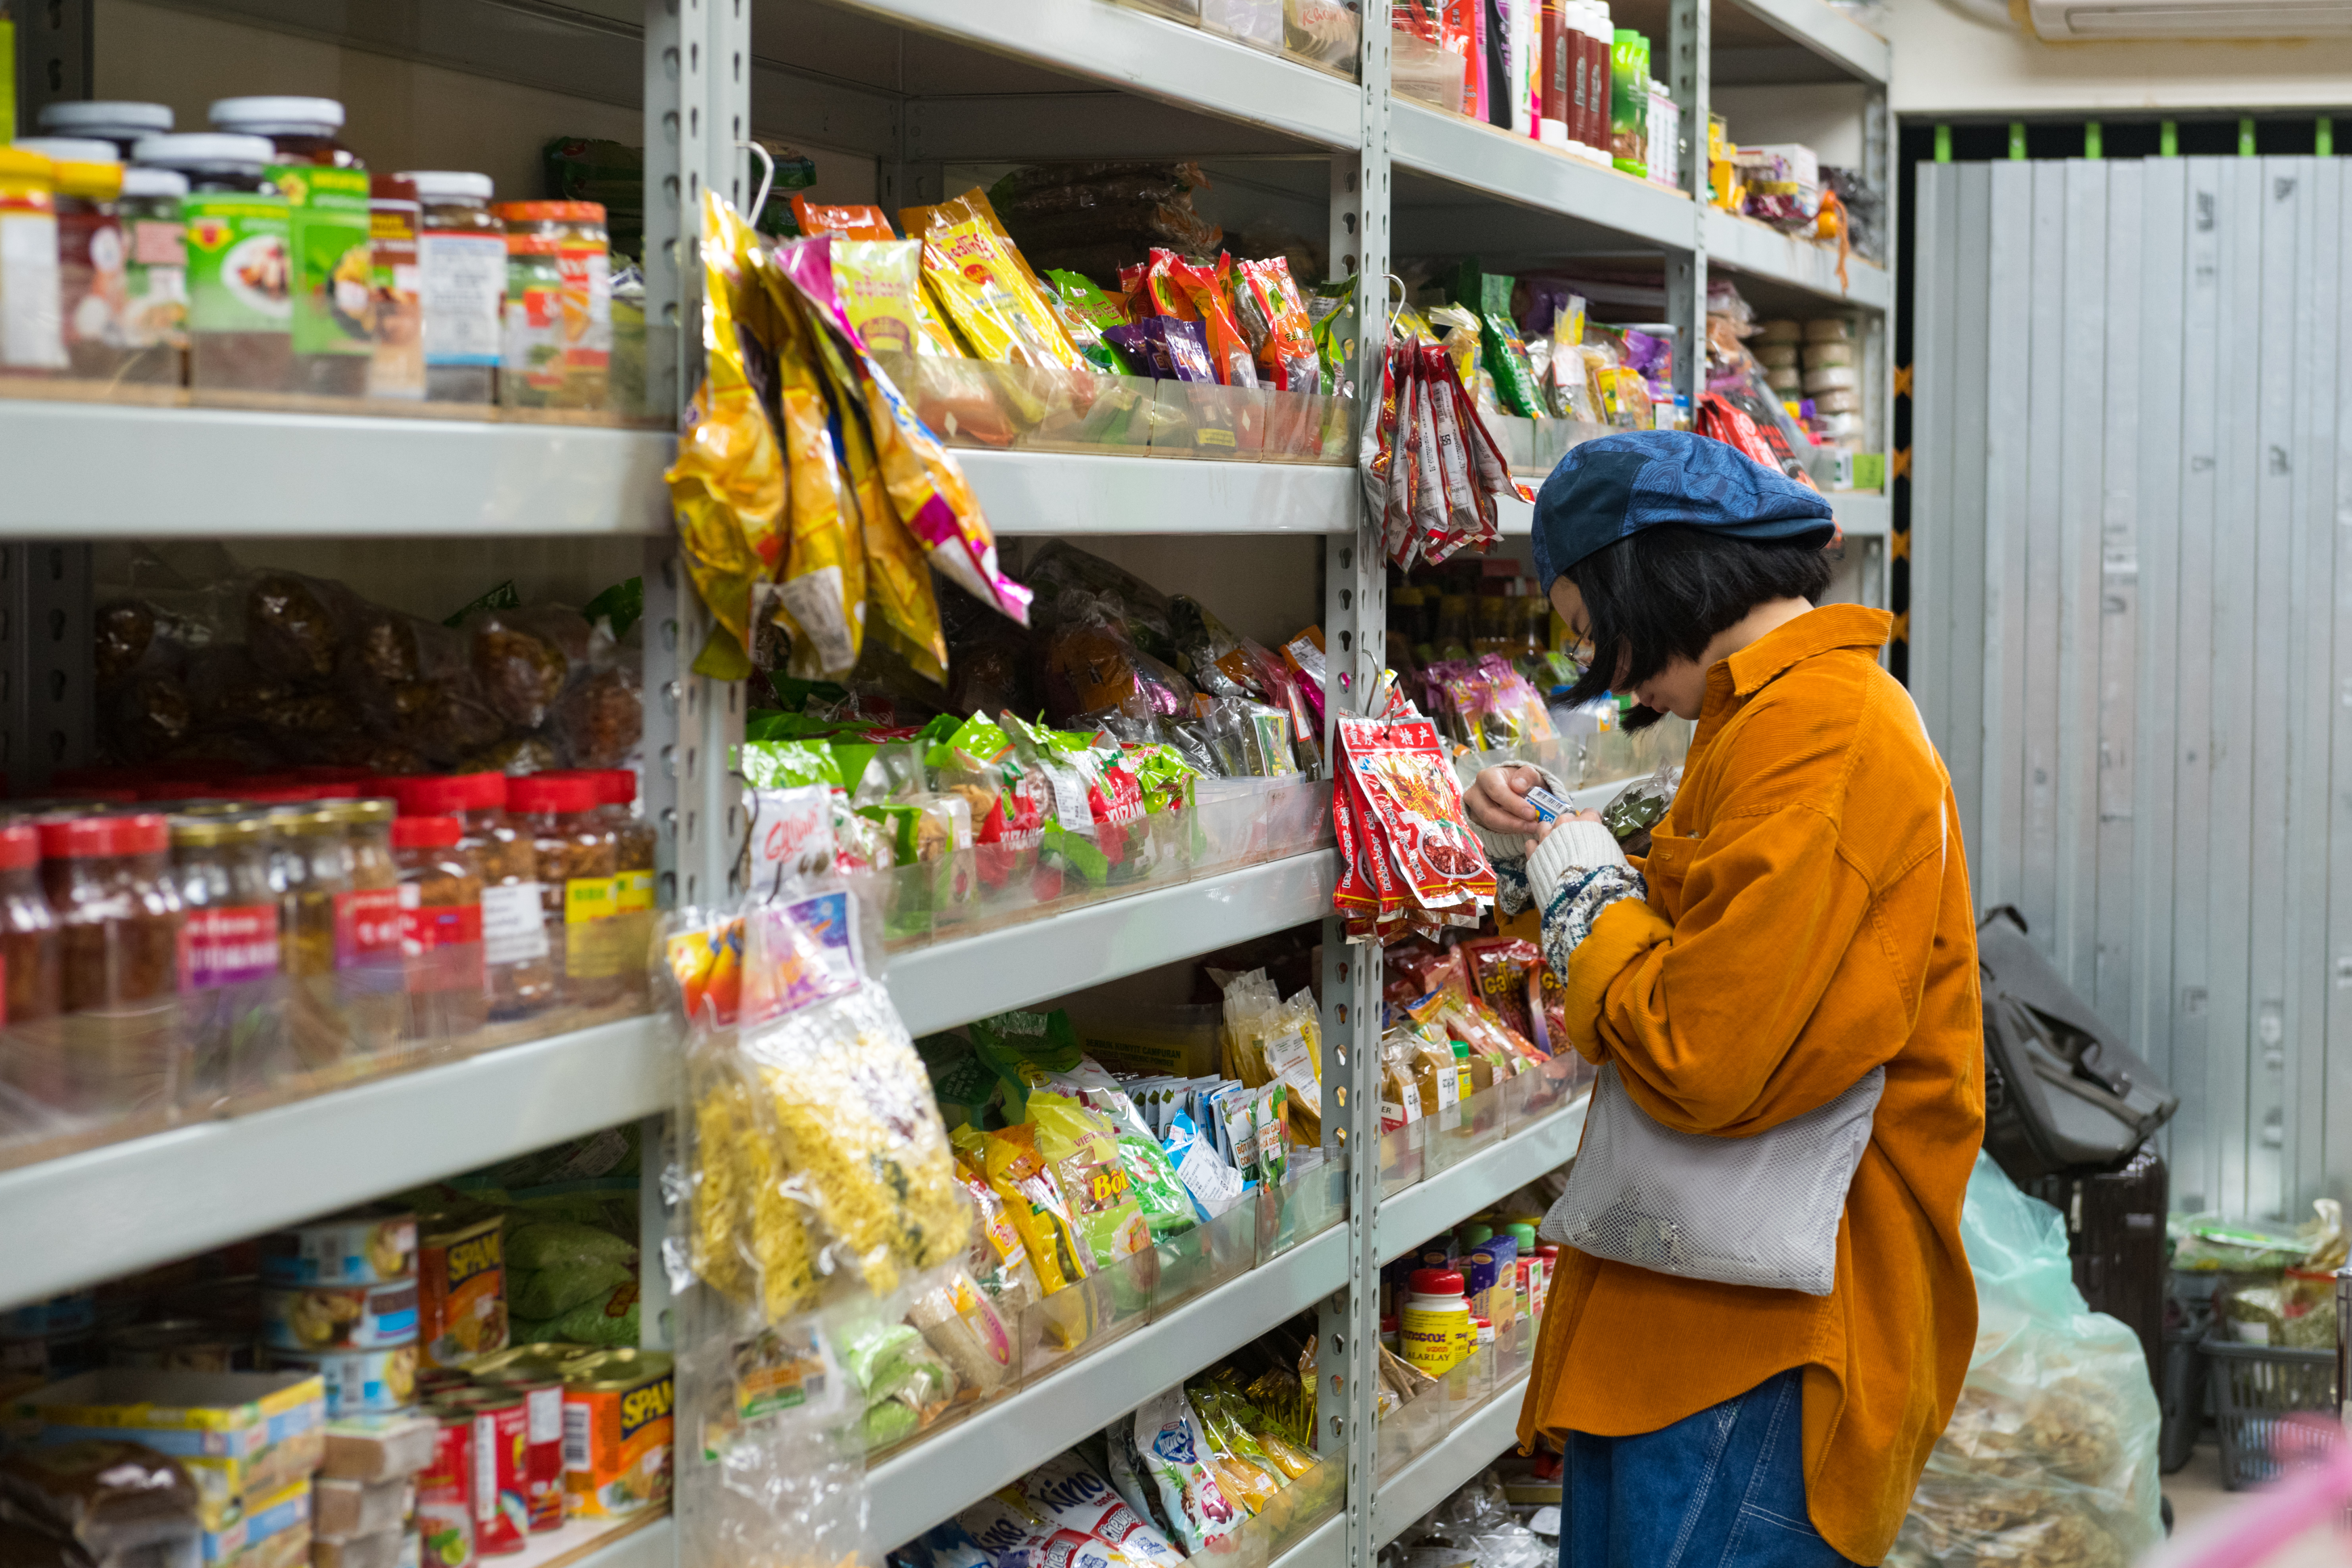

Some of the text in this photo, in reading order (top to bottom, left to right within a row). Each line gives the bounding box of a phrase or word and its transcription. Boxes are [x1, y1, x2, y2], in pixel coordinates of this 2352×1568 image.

[1348, 726, 1430, 746] 重庆 特产
[1086, 1038, 1181, 1059] SERBUK KUNYIT CAMPURAN
[1091, 1166, 1130, 1201] Bột
[1407, 1352, 1451, 1361] ALARLAY
[1093, 1492, 1120, 1507] candy
[1041, 1539, 1078, 1568] hewey
